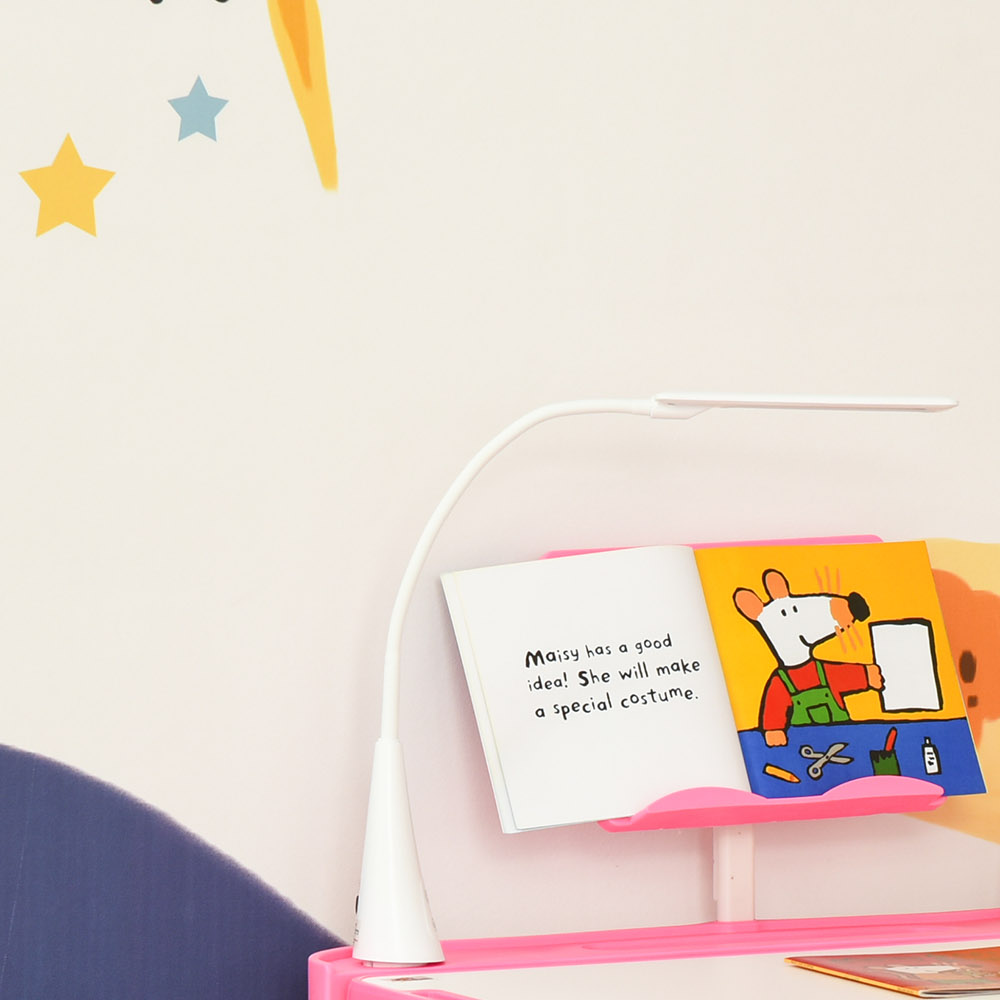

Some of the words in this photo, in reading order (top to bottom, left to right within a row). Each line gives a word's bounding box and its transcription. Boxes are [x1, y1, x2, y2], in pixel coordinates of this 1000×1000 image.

[525, 649, 580, 669] Maisy
[586, 644, 612, 659] has
[618, 643, 628, 654] a
[635, 633, 673, 655] good
[528, 672, 569, 692] idea!
[577, 669, 611, 687] She
[619, 661, 650, 680] will
[656, 658, 701, 677] make
[535, 708, 546, 718] a
[553, 692, 613, 721] special
[620, 687, 699, 710] costume.
